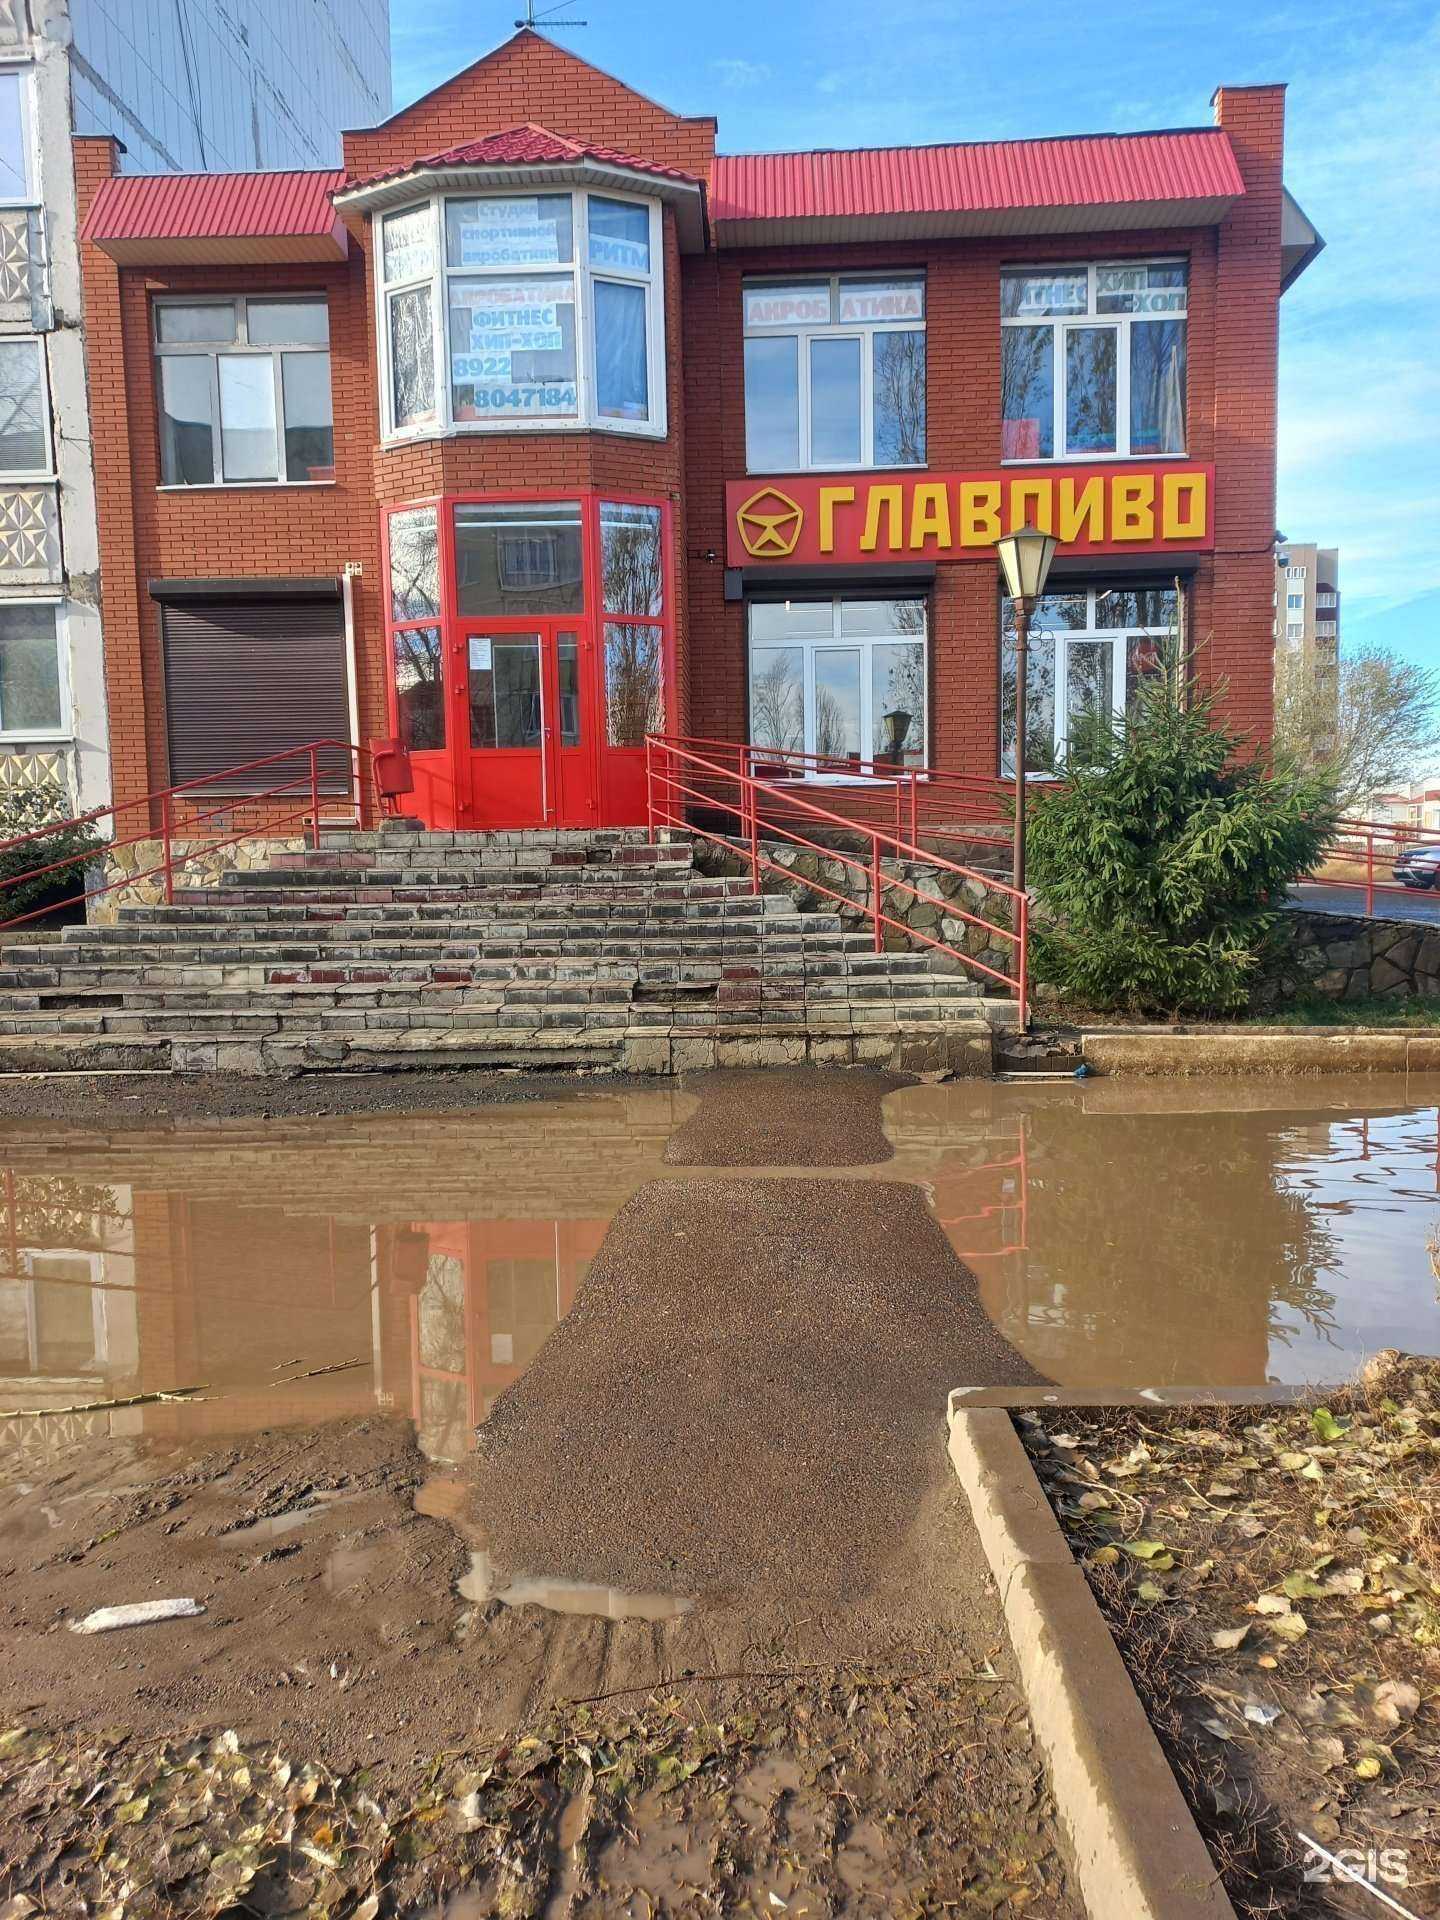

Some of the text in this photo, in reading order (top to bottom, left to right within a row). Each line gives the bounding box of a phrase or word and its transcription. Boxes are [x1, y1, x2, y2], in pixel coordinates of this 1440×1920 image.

[473, 308, 553, 327] ФИТНЕС
[471, 331, 561, 349] ХИП-ХОП
[454, 356, 511, 376] 8922
[475, 387, 577, 408] 8047184
[819, 473, 1206, 553] ГЛАВПИВО
